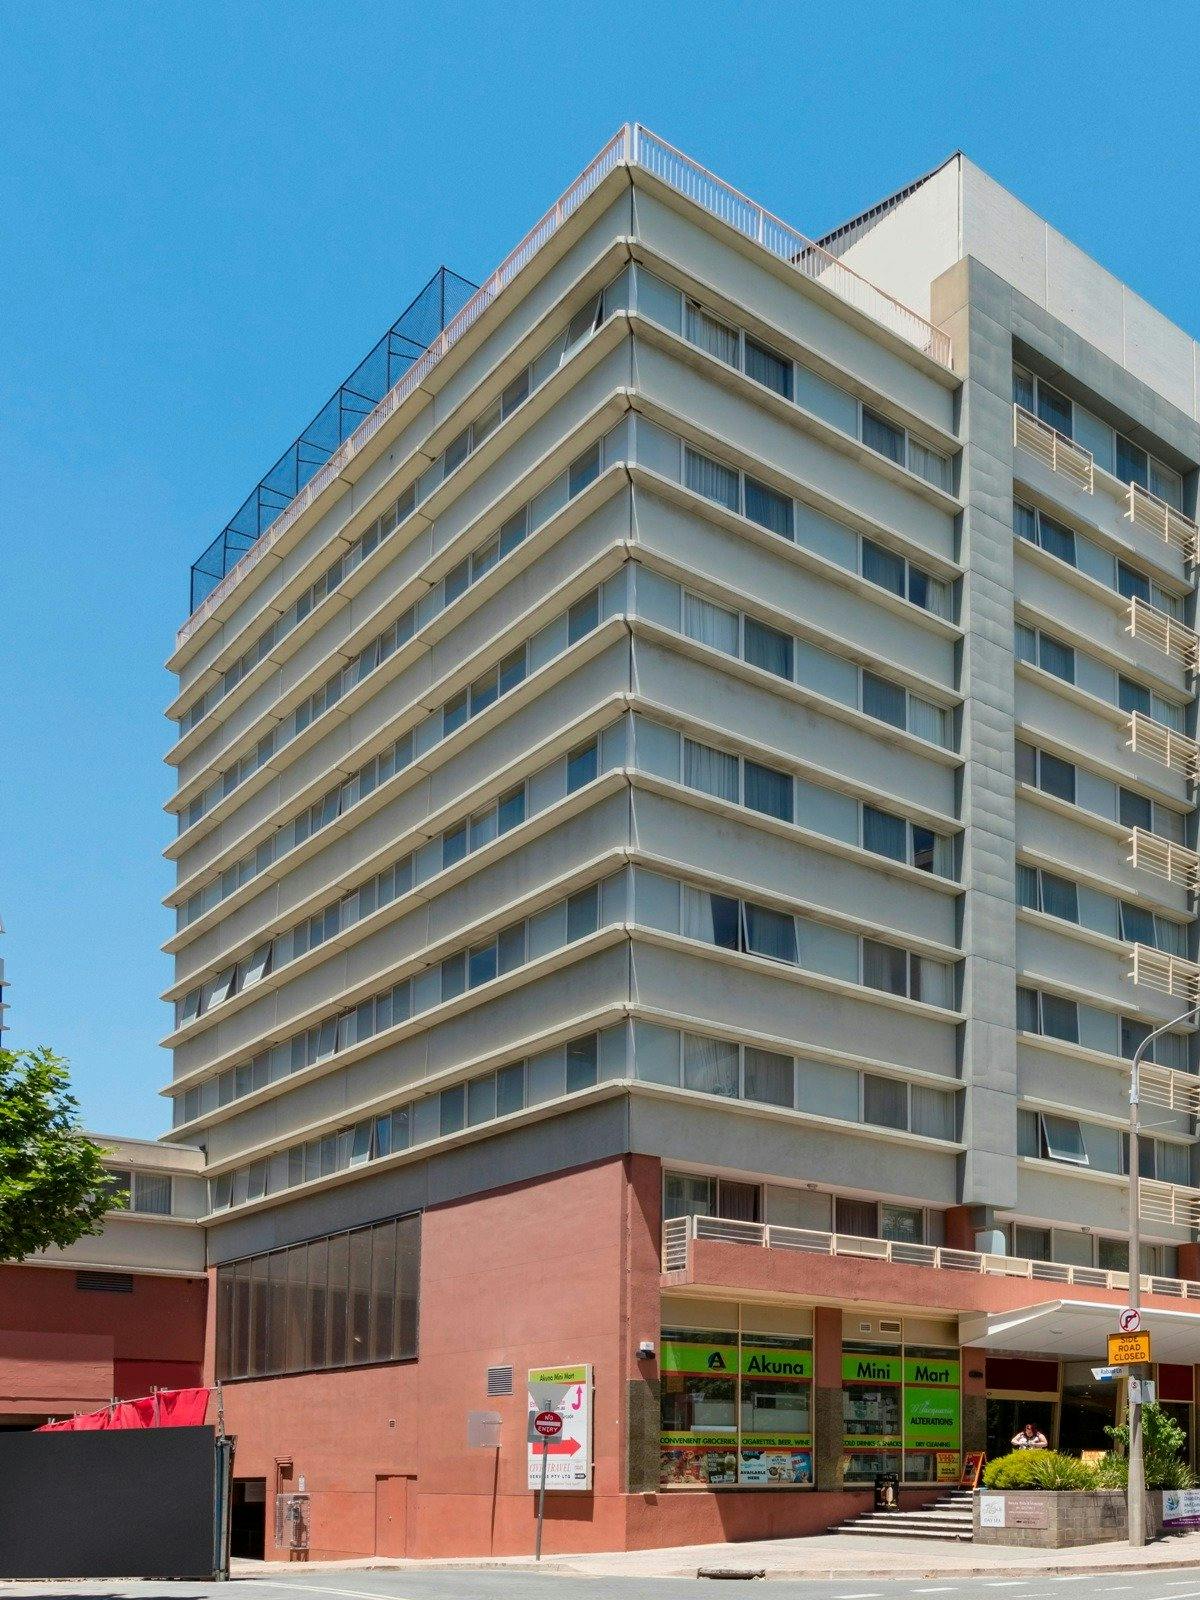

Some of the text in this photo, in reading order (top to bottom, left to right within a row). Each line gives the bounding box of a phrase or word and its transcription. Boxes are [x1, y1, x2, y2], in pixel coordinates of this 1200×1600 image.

[1120, 1336, 1139, 1344] SIDE
[1119, 1344, 1141, 1352] ROAD
[1114, 1352, 1146, 1361] CLOSED
[747, 1355, 804, 1375] Akuna
[857, 1362, 891, 1379] Mini
[915, 1366, 949, 1382] Mart
[910, 1417, 954, 1426] ALTERATIONS
[660, 1437, 701, 1445] CONVENIENT
